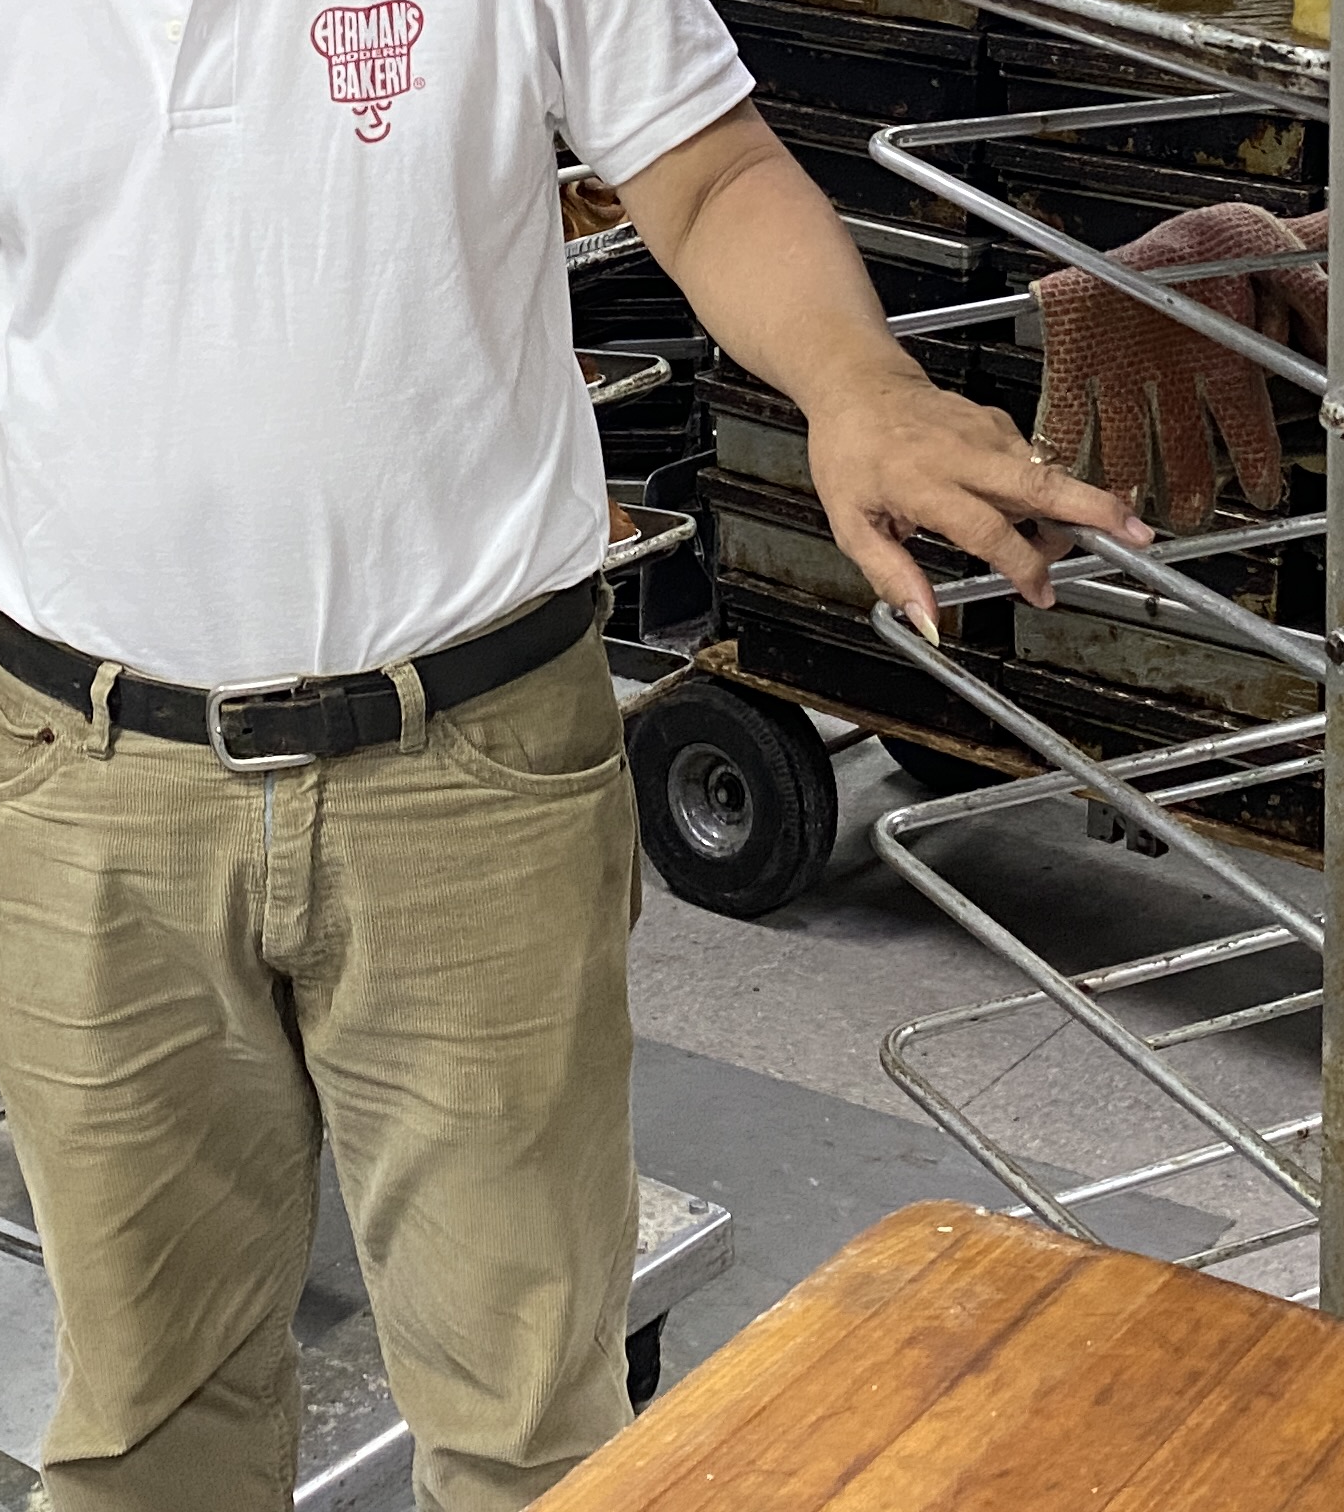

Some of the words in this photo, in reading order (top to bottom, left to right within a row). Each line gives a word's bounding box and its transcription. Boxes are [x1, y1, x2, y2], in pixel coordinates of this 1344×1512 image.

[314, 2, 420, 56] HERMAN'S
[331, 45, 408, 65] MODERN
[332, 55, 408, 99] BAKERY
